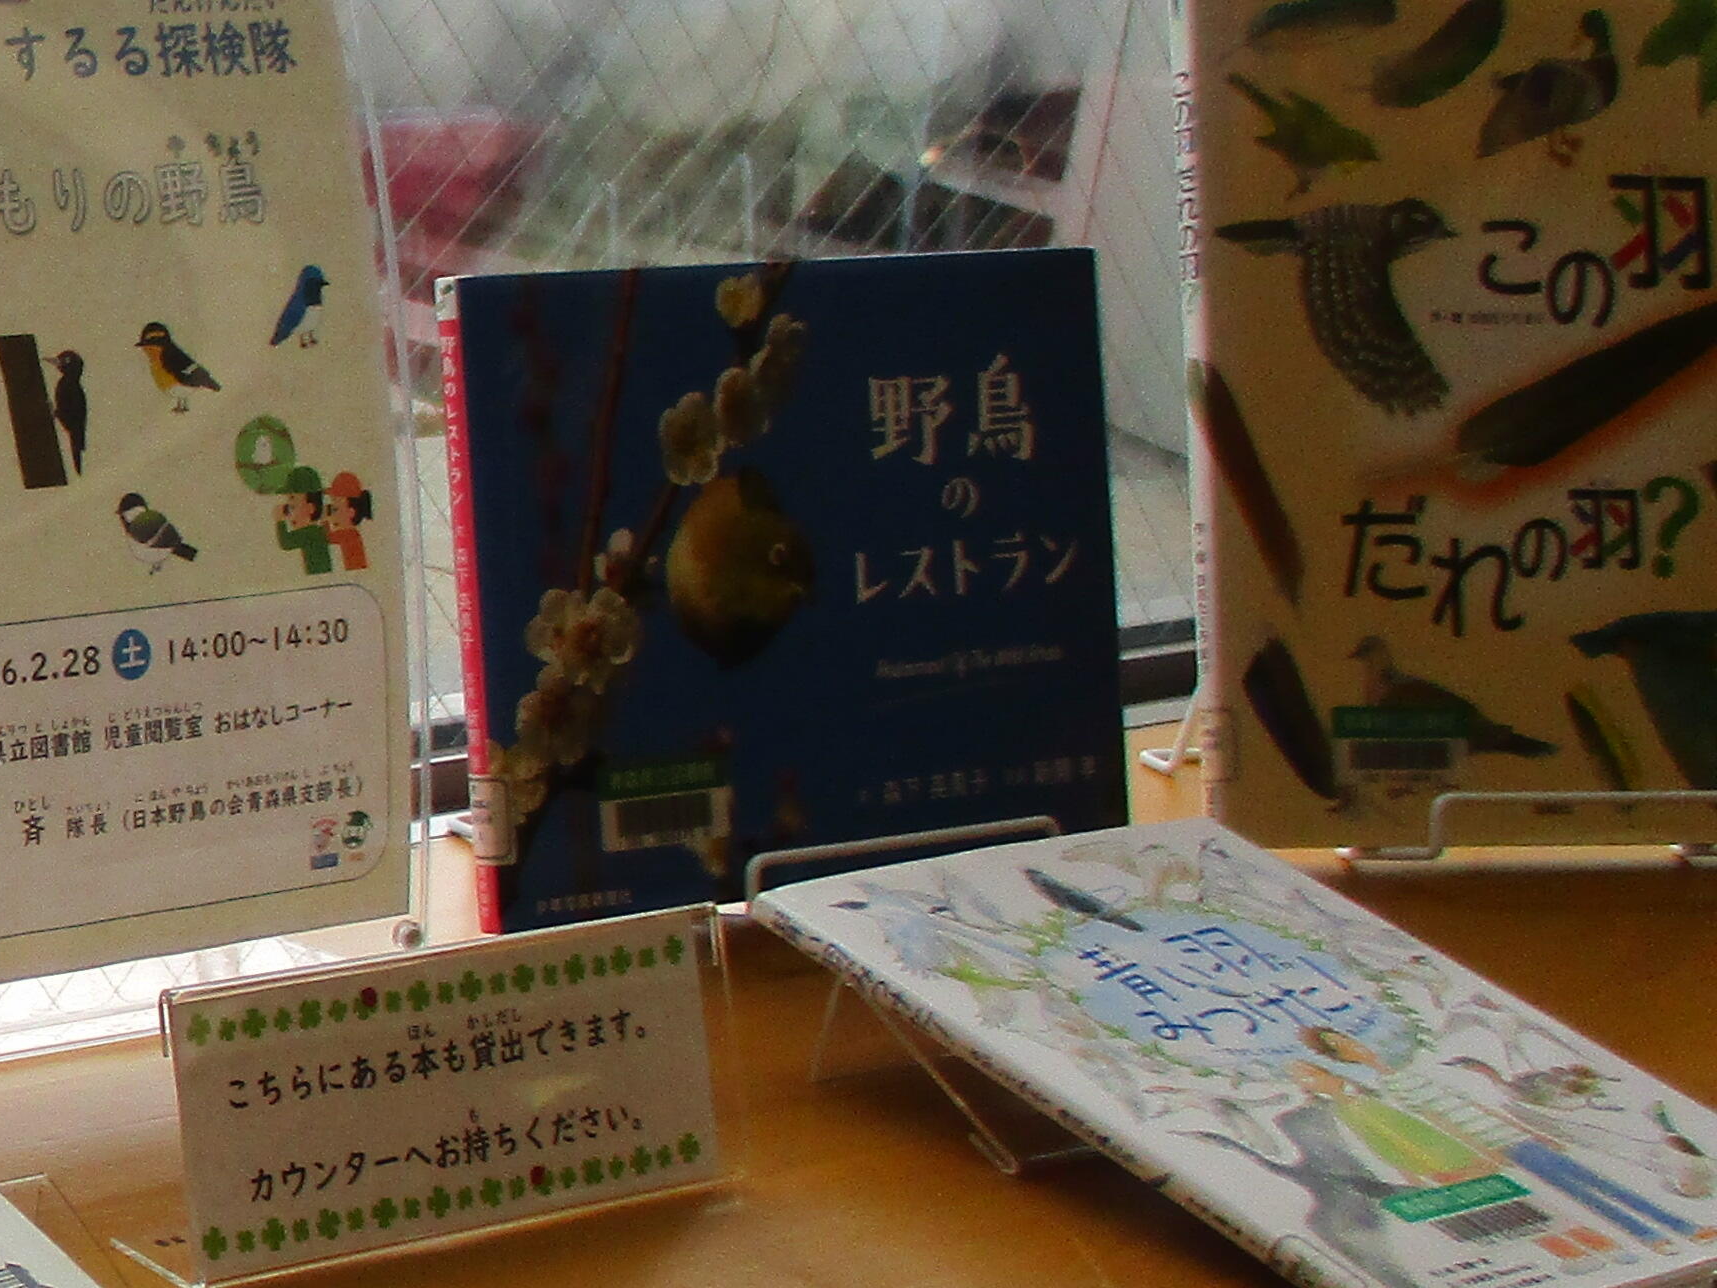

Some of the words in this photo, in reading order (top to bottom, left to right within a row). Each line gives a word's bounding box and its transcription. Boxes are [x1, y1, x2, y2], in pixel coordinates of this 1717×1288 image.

[1477, 172, 1714, 329] この羽
[867, 352, 1040, 467] 野鳥
[940, 475, 983, 519] の
[852, 531, 1081, 605] レストラン
[1342, 475, 1703, 640] だれの羽？
[103, 714, 204, 751] 児童閲覧室
[213, 698, 353, 735] おはなしコーナー
[1075, 924, 1282, 1007] 青い羽
[227, 1009, 649, 1110] こちらにある本も貸出できます。
[249, 1105, 645, 1204] カウンターへお持ちください。
